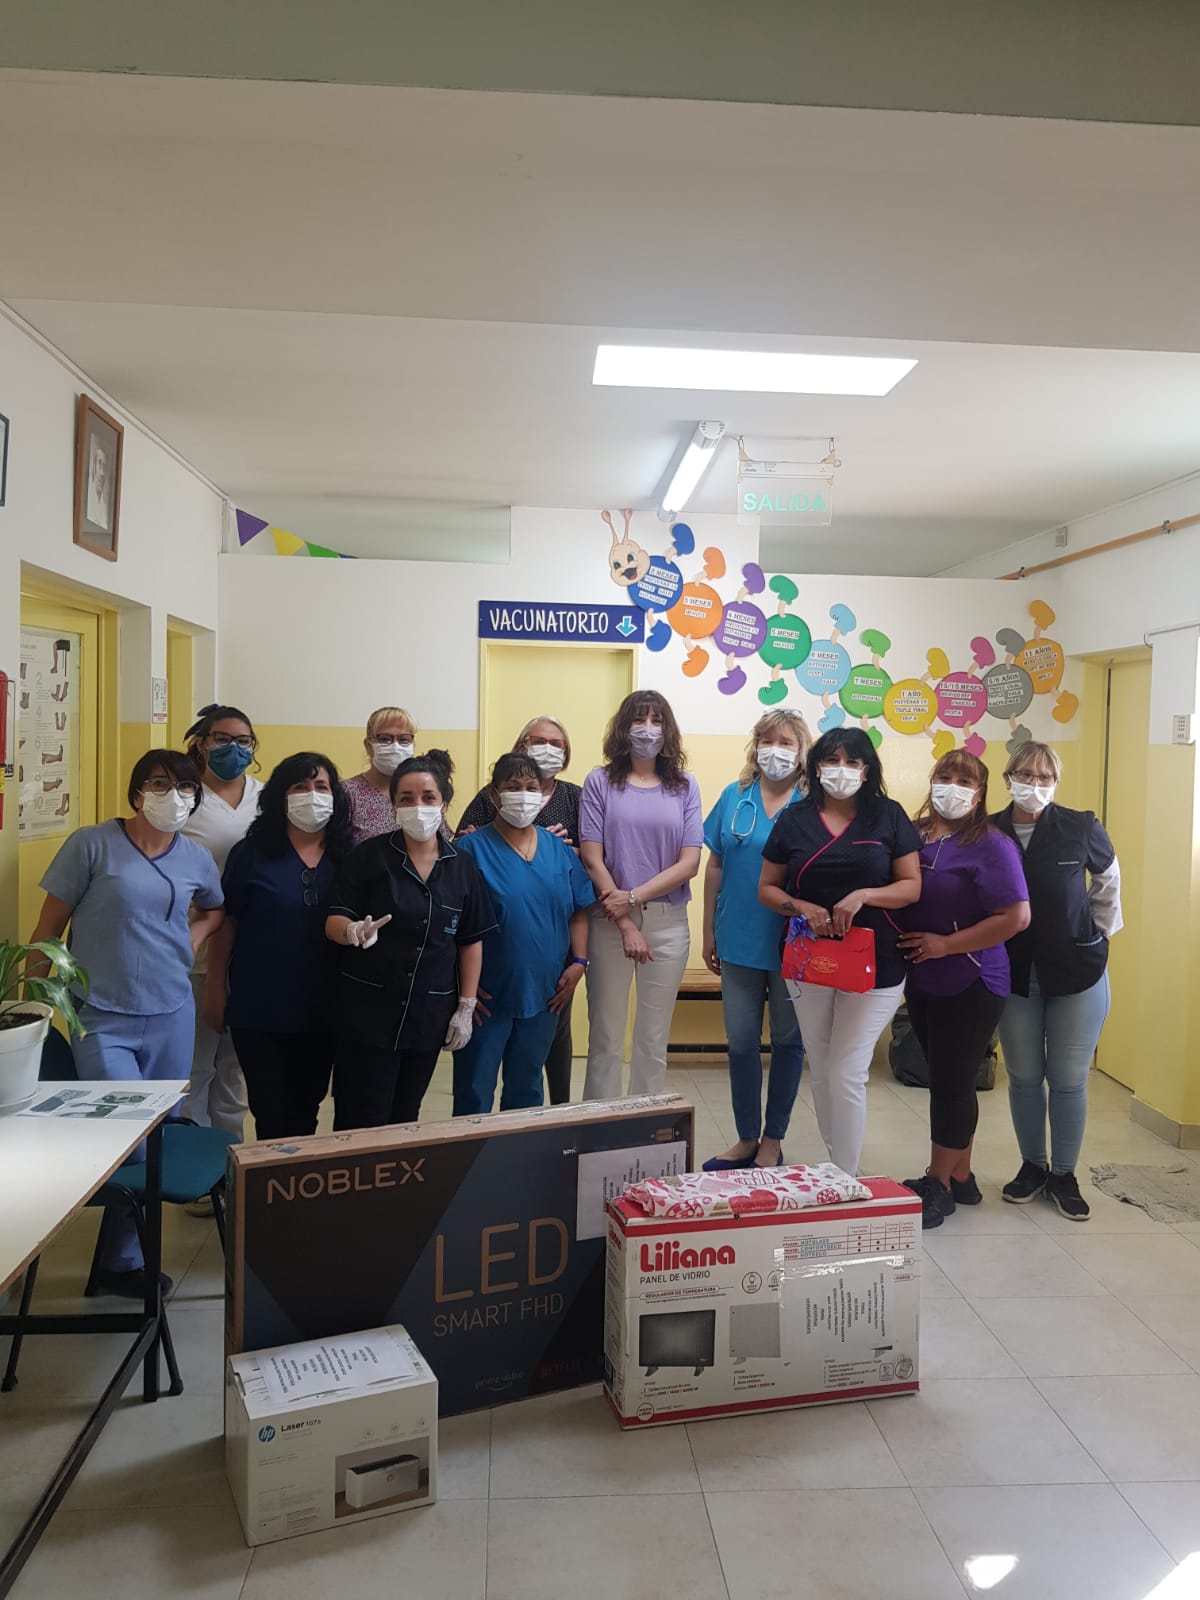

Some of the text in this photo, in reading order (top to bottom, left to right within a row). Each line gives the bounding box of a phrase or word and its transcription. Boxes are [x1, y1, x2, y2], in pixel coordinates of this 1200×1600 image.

[743, 493, 826, 512] SALIDA
[656, 570, 678, 581] MESES
[690, 599, 712, 607] MESES
[490, 608, 609, 634] VACUNATORIO
[733, 613, 755, 623] MESES
[777, 630, 799, 639] MESES
[610, 1097, 675, 1112] NOBLEX
[266, 1158, 425, 1204] NOBLEX
[435, 1217, 569, 1303] LED
[640, 1240, 736, 1272] Liliana
[640, 1270, 710, 1286] PANEL DE VIDRIO
[682, 1287, 716, 1295] TEMPERATURA
[433, 1293, 563, 1336] SMART FHD
[259, 1425, 275, 1443] hp
[281, 1420, 305, 1432] Laser
